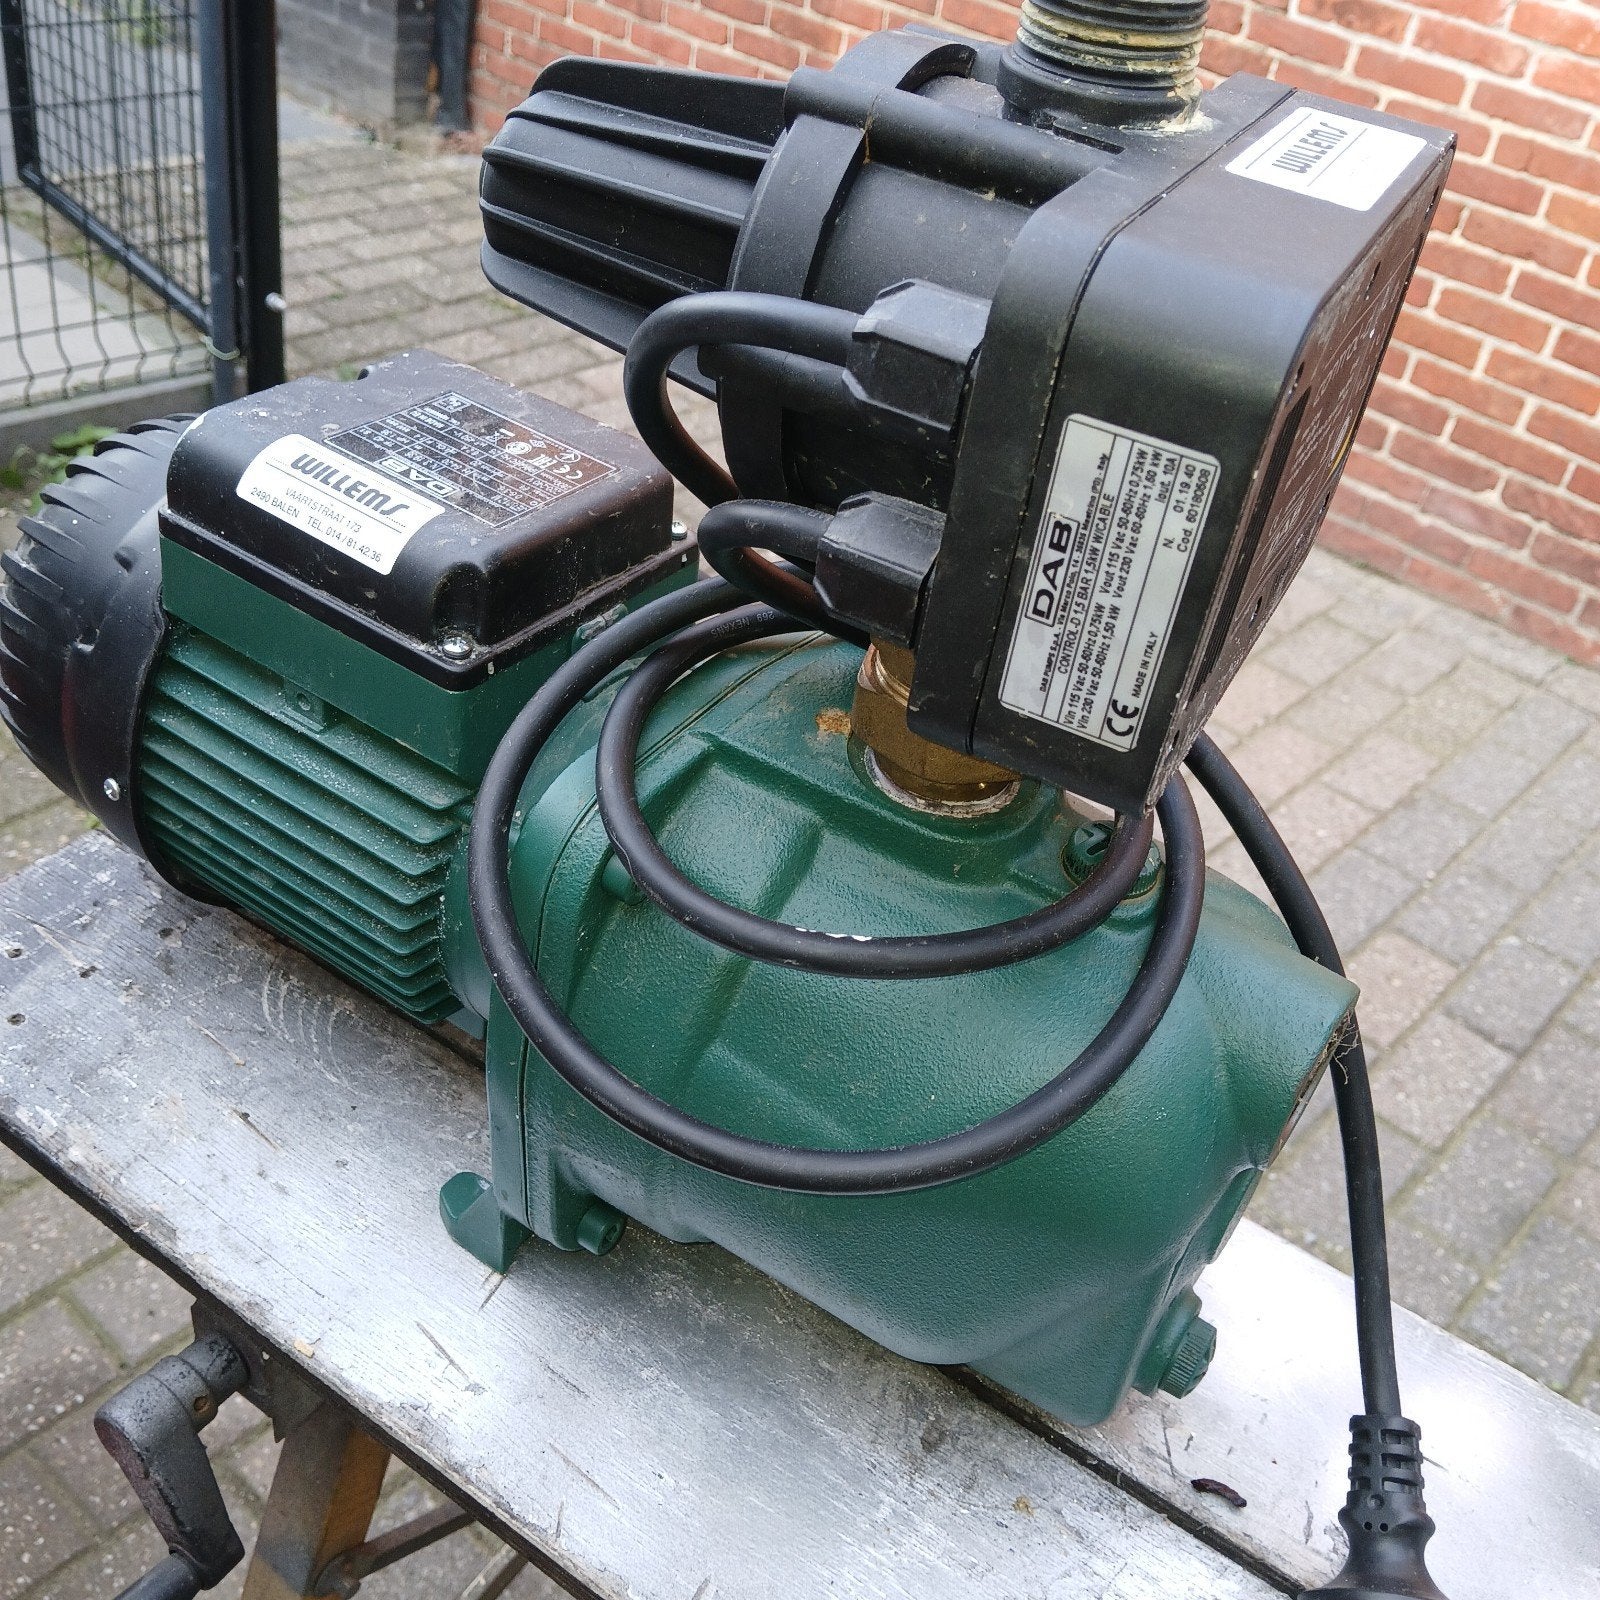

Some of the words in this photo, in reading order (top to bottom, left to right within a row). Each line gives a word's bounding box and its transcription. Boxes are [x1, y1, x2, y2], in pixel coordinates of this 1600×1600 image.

[1271, 122, 1348, 174] WILLEMS
[1150, 450, 1162, 467] kW
[1162, 458, 1177, 475] 10A
[290, 454, 410, 516] WILLEMS
[382, 458, 454, 494] DAB
[250, 487, 270, 503] 2490
[271, 497, 300, 518] BALEN
[307, 516, 324, 531] TEL.
[326, 526, 342, 540] 014
[286, 490, 345, 523] VAARTSTRAAT
[346, 520, 362, 533] 173
[1092, 493, 1115, 544] W/CABLE
[1111, 531, 1126, 550] Vac
[1124, 536, 1138, 554] Vac
[1177, 526, 1192, 552] Cod.
[1032, 520, 1072, 620] DAB
[1084, 545, 1100, 574] 1,5kW
[1106, 552, 1120, 568] 115
[1119, 556, 1133, 575] 230
[1077, 577, 1092, 600] BAR
[1099, 570, 1115, 594] Vout
[1112, 575, 1128, 598] Vout
[1073, 601, 1085, 614] 1,5
[1107, 604, 1120, 621] kW
[1058, 617, 1081, 674] CONTROL-D
[1144, 632, 1158, 659] ITALY
[1043, 652, 1055, 677] PUMPS
[1140, 660, 1150, 670] IN
[1072, 675, 1086, 692] Vac
[1086, 680, 1100, 696] Vac
[1132, 671, 1146, 698] MADE
[1068, 692, 1080, 708] 115
[1081, 697, 1094, 714] 230
